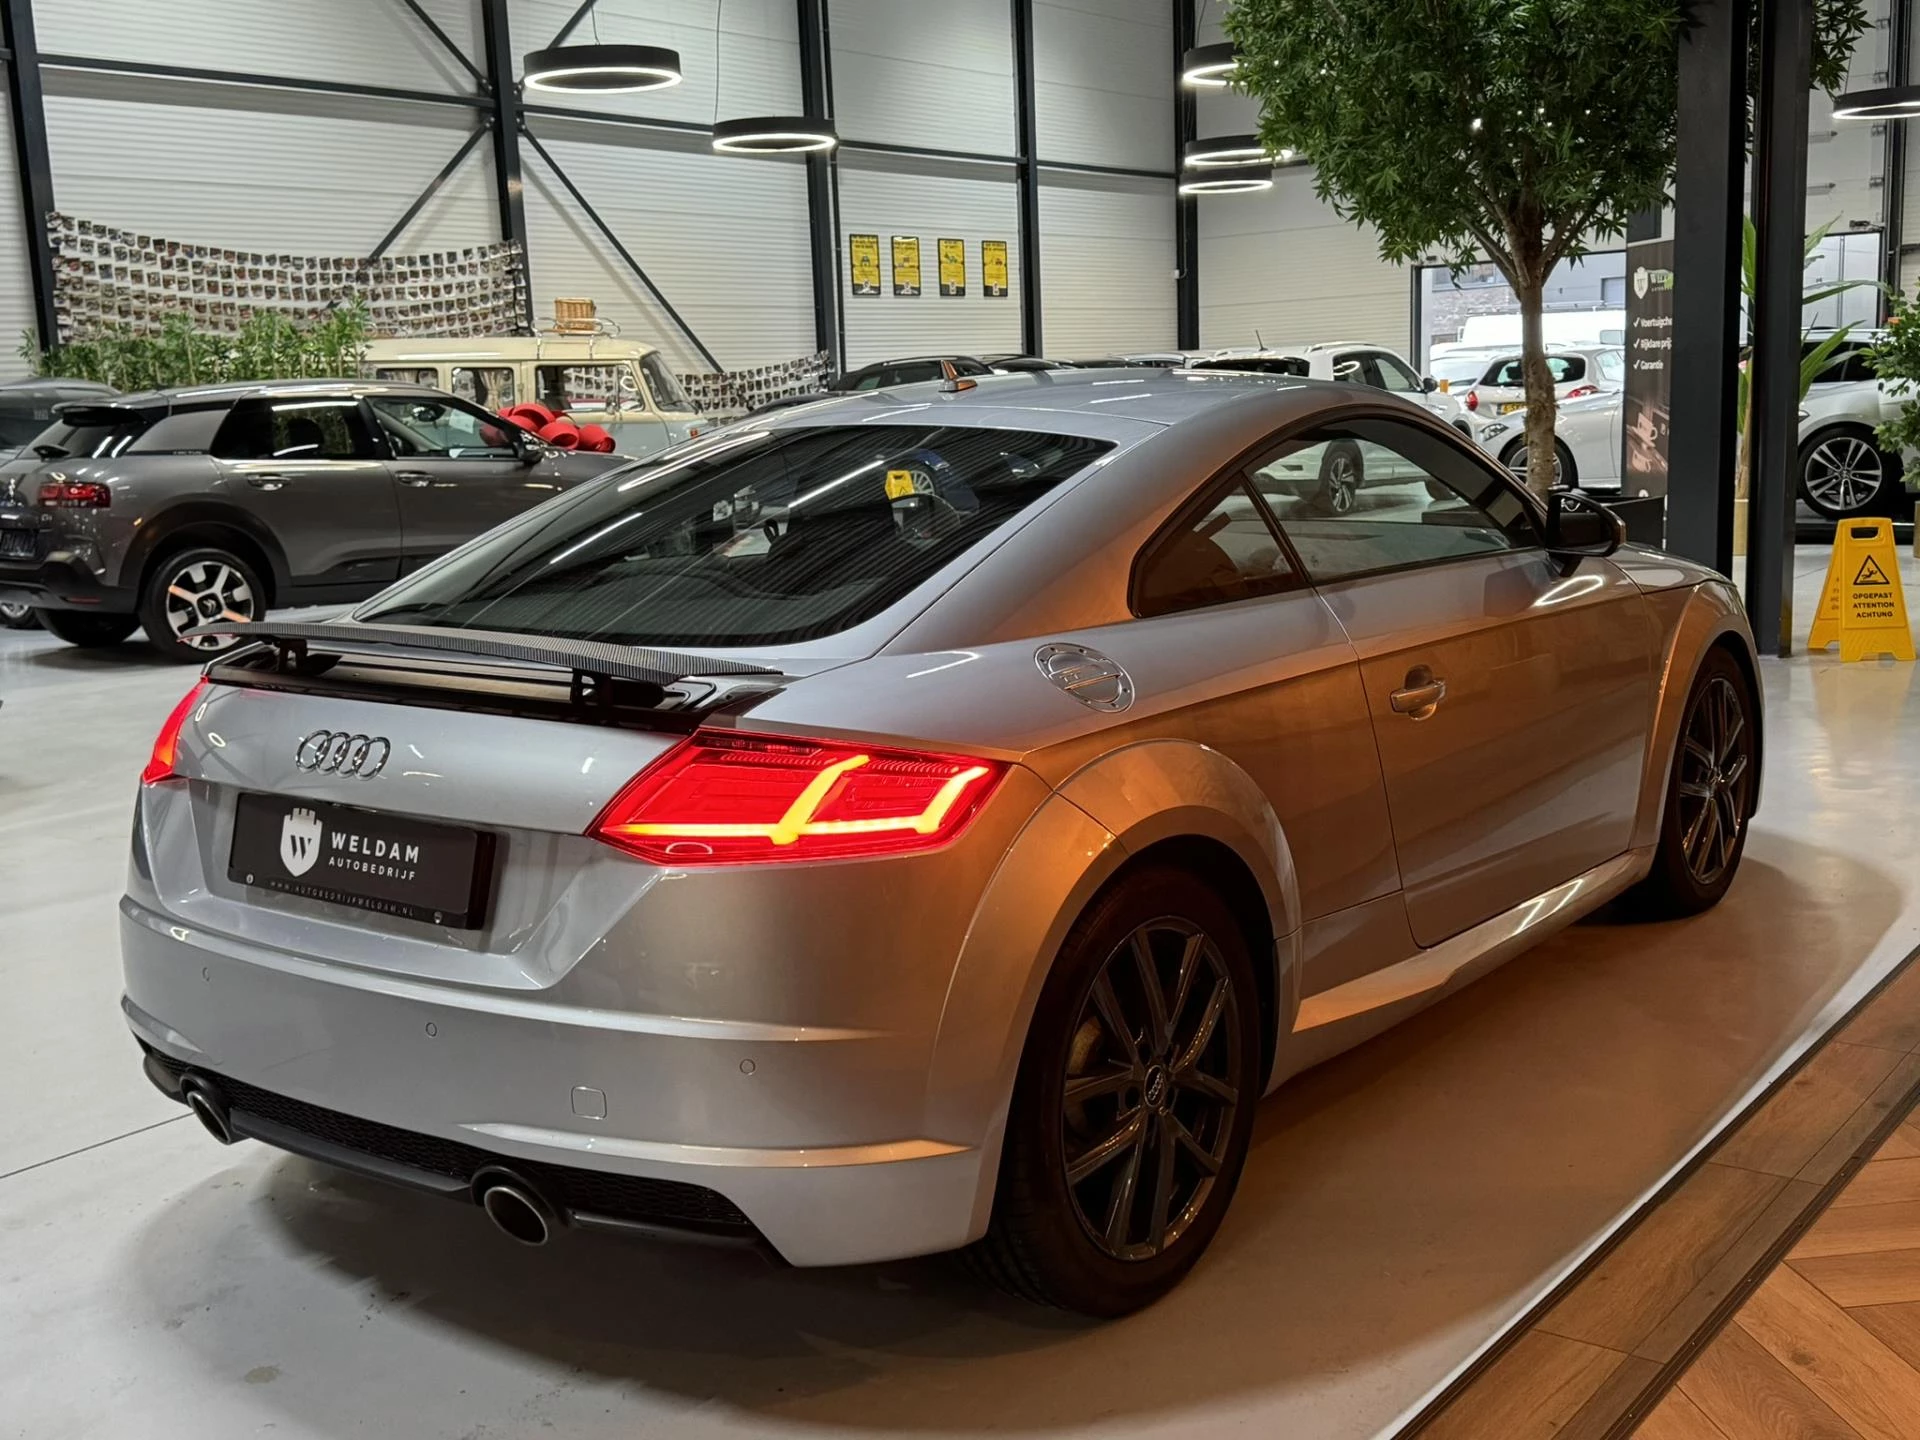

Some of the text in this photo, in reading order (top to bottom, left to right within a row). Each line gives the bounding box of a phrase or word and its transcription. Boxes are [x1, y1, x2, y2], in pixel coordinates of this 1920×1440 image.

[1640, 360, 1664, 370] Garantie
[1852, 592, 1893, 600] OPGEPAST
[331, 831, 420, 864] WELDAM
[328, 856, 417, 881] AUTOBEDRIJF
